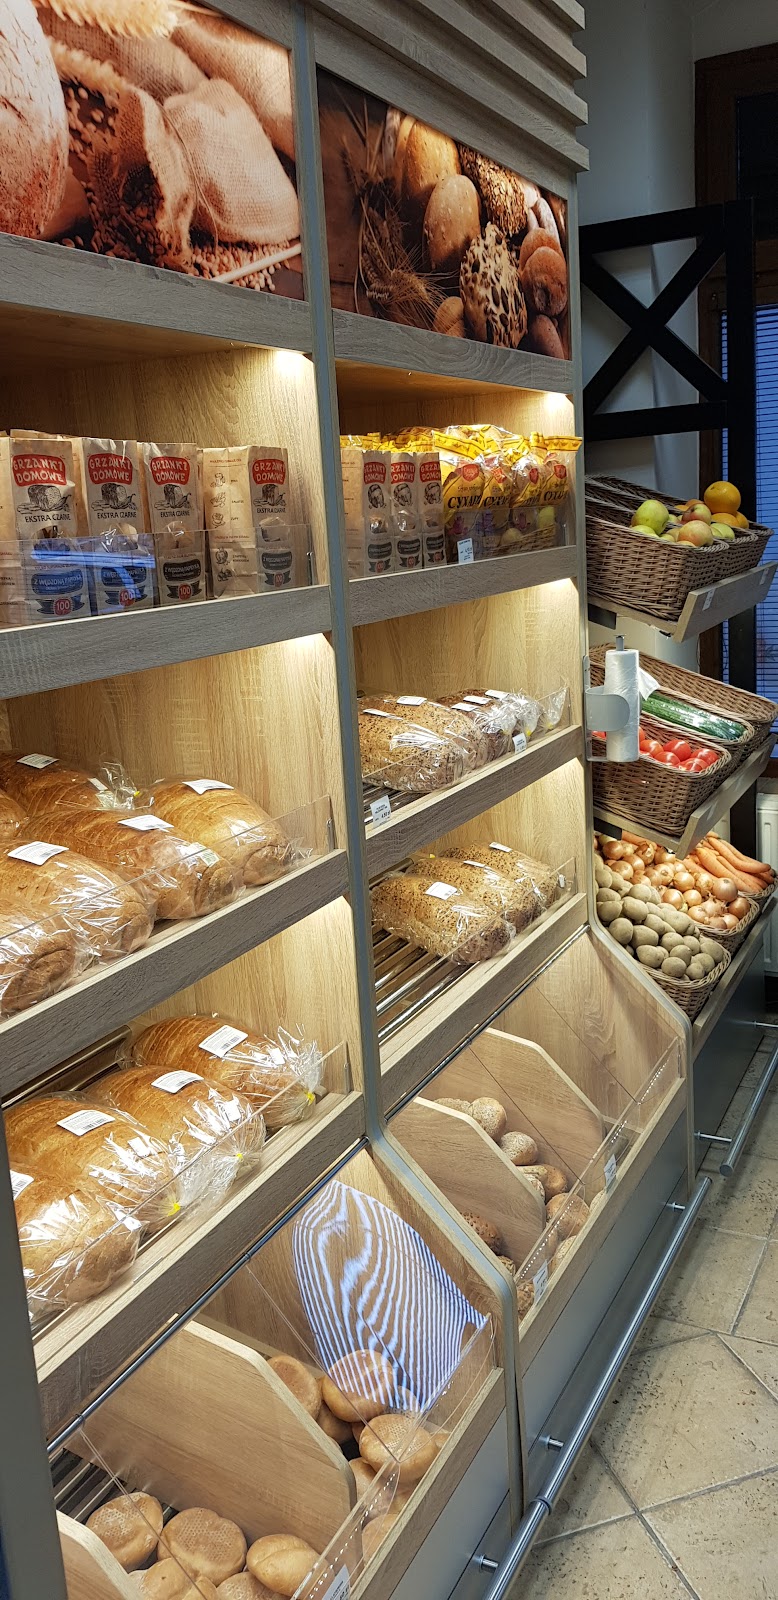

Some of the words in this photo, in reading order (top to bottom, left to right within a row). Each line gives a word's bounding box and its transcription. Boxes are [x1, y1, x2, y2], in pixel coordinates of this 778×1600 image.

[13, 457, 63, 471] GRZANKI
[89, 458, 131, 471] GRZANKI
[151, 458, 188, 471] GRZANKI
[253, 461, 286, 472] GRZANKI
[391, 464, 415, 473] RZANKI
[420, 464, 440, 472] GRZA
[16, 470, 65, 483] DOMOWE
[92, 469, 130, 481] DOMOWE
[155, 470, 186, 482] DOMOWE
[256, 472, 284, 483] DOMOWE
[422, 473, 441, 481] DOMO
[25, 514, 51, 523] EKSTRA
[52, 513, 71, 521] CZARNE
[97, 512, 119, 520] EKSTRA
[120, 511, 137, 519] CZARNE
[160, 510, 175, 518] EKSTRA
[121, 590, 133, 600] 100
[180, 587, 190, 595] 100
[56, 601, 70, 611] 100
